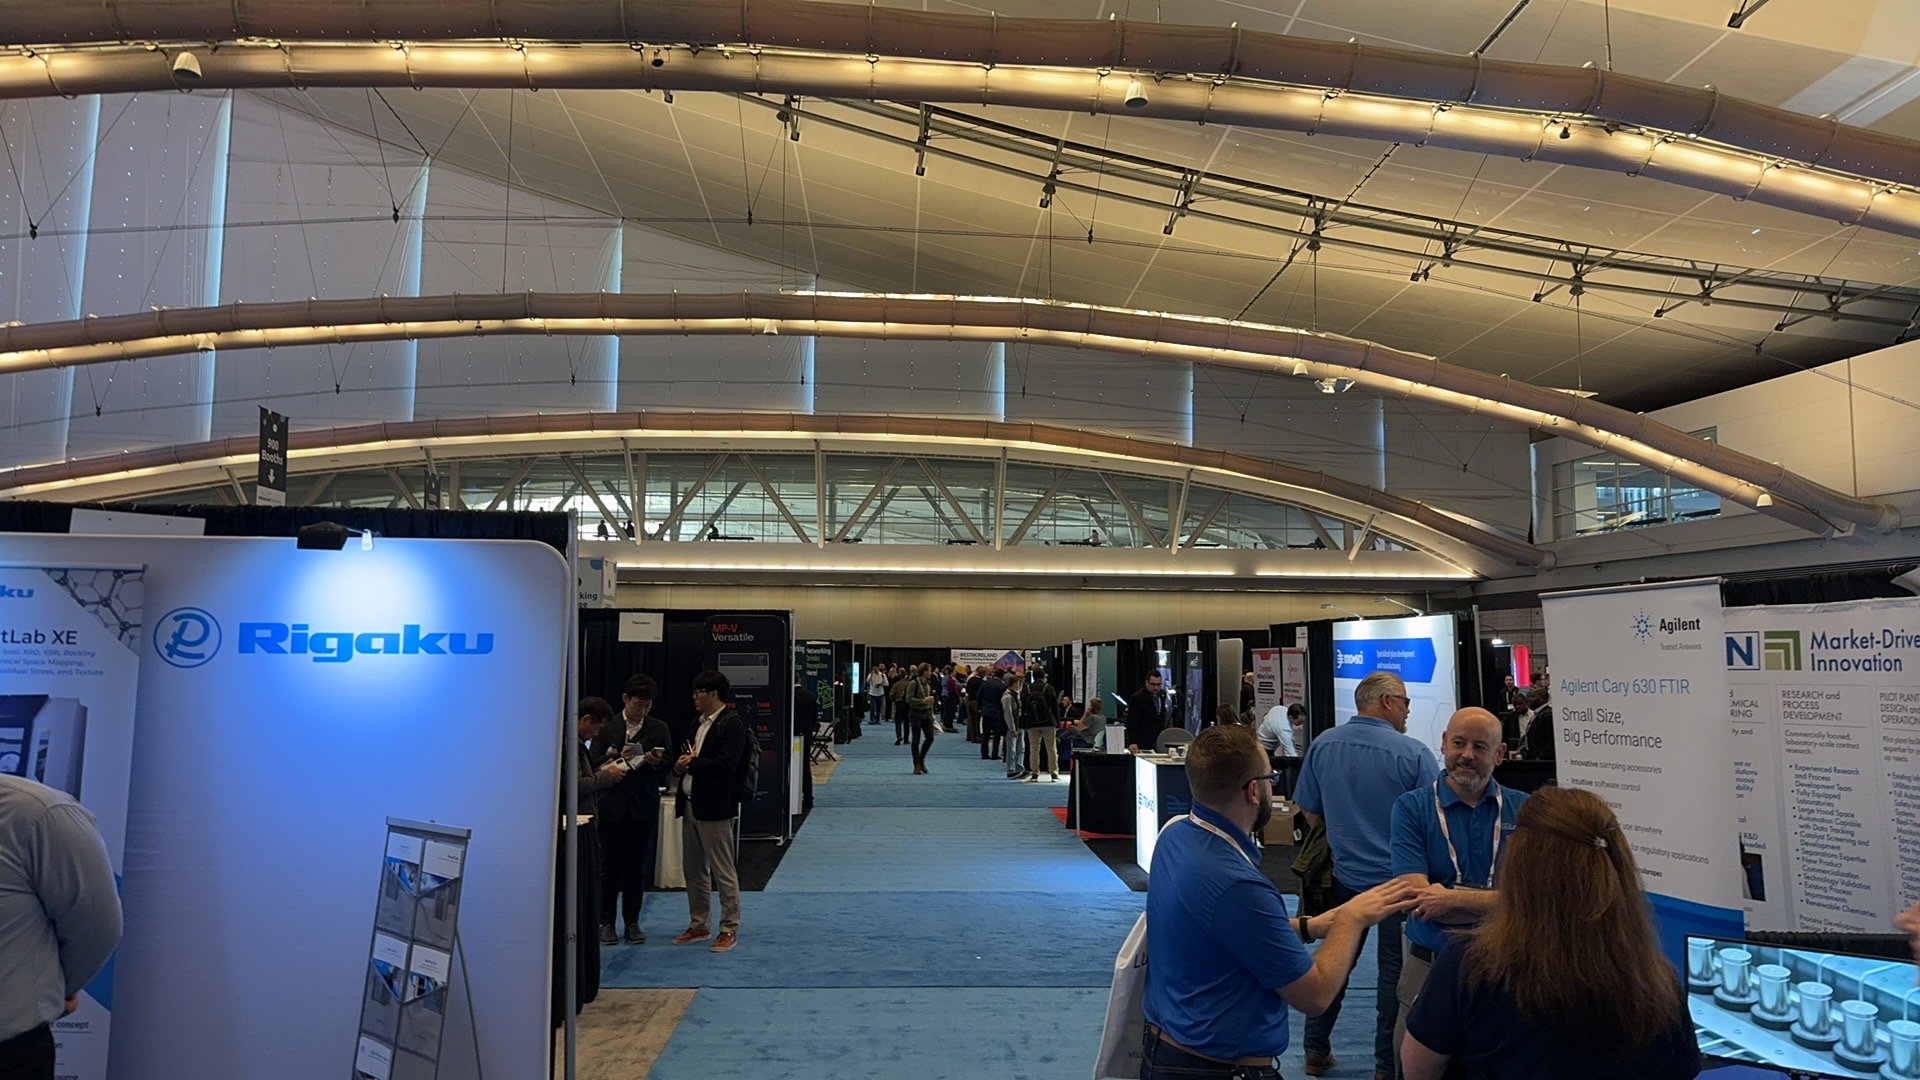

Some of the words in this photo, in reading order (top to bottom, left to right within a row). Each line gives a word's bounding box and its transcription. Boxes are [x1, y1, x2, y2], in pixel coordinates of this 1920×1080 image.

[267, 438, 279, 451] 900
[262, 450, 283, 465] Booths
[712, 624, 738, 632] MP-V
[1659, 618, 1701, 634] Agilent
[52, 630, 78, 646] XE
[239, 622, 494, 662] Rigaku
[712, 633, 754, 642] Versatile
[1811, 628, 1920, 650] Market-Drive
[1726, 636, 1753, 666] N
[1811, 652, 1902, 672] Innovation
[1561, 679, 1599, 696] Agilent
[1602, 679, 1630, 697] Cary
[1632, 679, 1657, 694] 630
[1659, 680, 1690, 695] FTIR
[1782, 690, 1824, 700] RESEARCH
[1825, 691, 1841, 700] and
[1879, 692, 1898, 702] PILOT
[1782, 700, 1820, 710] PROCESS
[1880, 703, 1908, 713] DESIGN
[1562, 707, 1593, 722] Small
[1596, 709, 1625, 725] Size,
[1783, 711, 1843, 721] DEVELOPMENT
[1563, 729, 1580, 746] Big
[1583, 729, 1662, 748] Performance
[1784, 730, 1825, 740] Commercially
[1785, 738, 1835, 748] laboratory-scale
[1570, 758, 1598, 768] Innovative
[1600, 761, 1626, 772] sampling
[1627, 764, 1662, 774] accessories
[1795, 763, 1832, 773] Experienced
[1833, 767, 1860, 775] Research
[1808, 773, 1831, 781] Process
[1571, 778, 1593, 787] Intuitive
[1594, 780, 1620, 790] software
[1795, 780, 1835, 789] Development
[1836, 783, 1852, 792] Team
[1796, 788, 1810, 798] Fully
[1811, 790, 1841, 800] Equipped
[1796, 798, 1834, 807] Laboratories
[1797, 806, 1815, 815] Large
[1816, 807, 1834, 816] Hood
[1835, 809, 1855, 818] Space
[1798, 814, 1833, 824] Automation
[1835, 818, 1861, 828] Capable
[1634, 825, 1663, 836] anywhere
[1812, 823, 1828, 832] Data
[1829, 825, 1855, 837] Tracking
[1800, 831, 1825, 841] Catalyst
[1826, 834, 1856, 846] Screening
[1800, 839, 1840, 850] Development
[1640, 845, 1670, 858] regulatory
[1670, 849, 1709, 864] applications
[1801, 848, 1838, 859] Separations
[1839, 852, 1867, 863] Expertise
[1802, 864, 1859, 879] Commercialization
[1803, 872, 1839, 886] Technology
[1840, 880, 1871, 890] Validation
[1804, 881, 1828, 893] Existing
[1804, 890, 1848, 903] Improvements
[1805, 898, 1840, 911] Renewable
[1841, 904, 1877, 918] Chemistries
